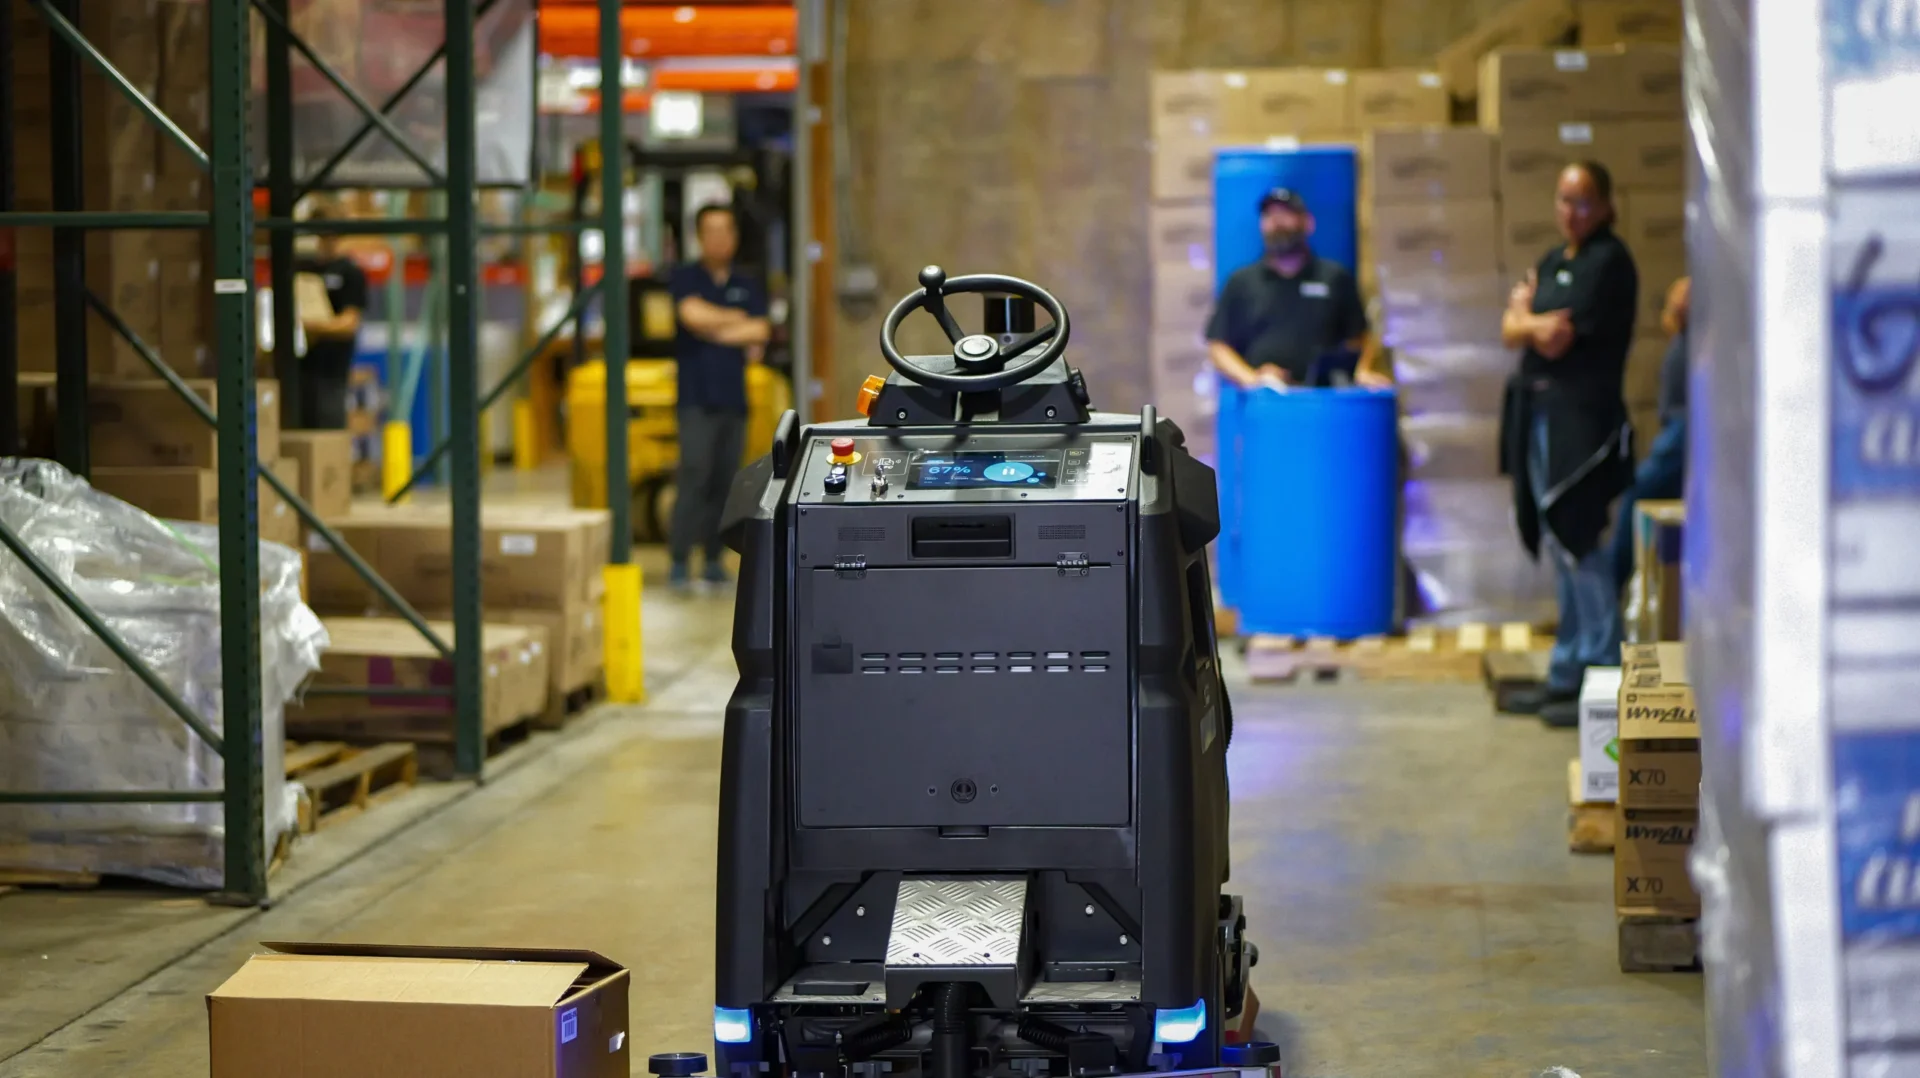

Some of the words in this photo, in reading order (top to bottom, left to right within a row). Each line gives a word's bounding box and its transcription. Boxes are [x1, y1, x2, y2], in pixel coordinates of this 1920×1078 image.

[928, 466, 972, 474] 67%
[1628, 768, 1667, 786] X70
[1626, 876, 1664, 894] X70
